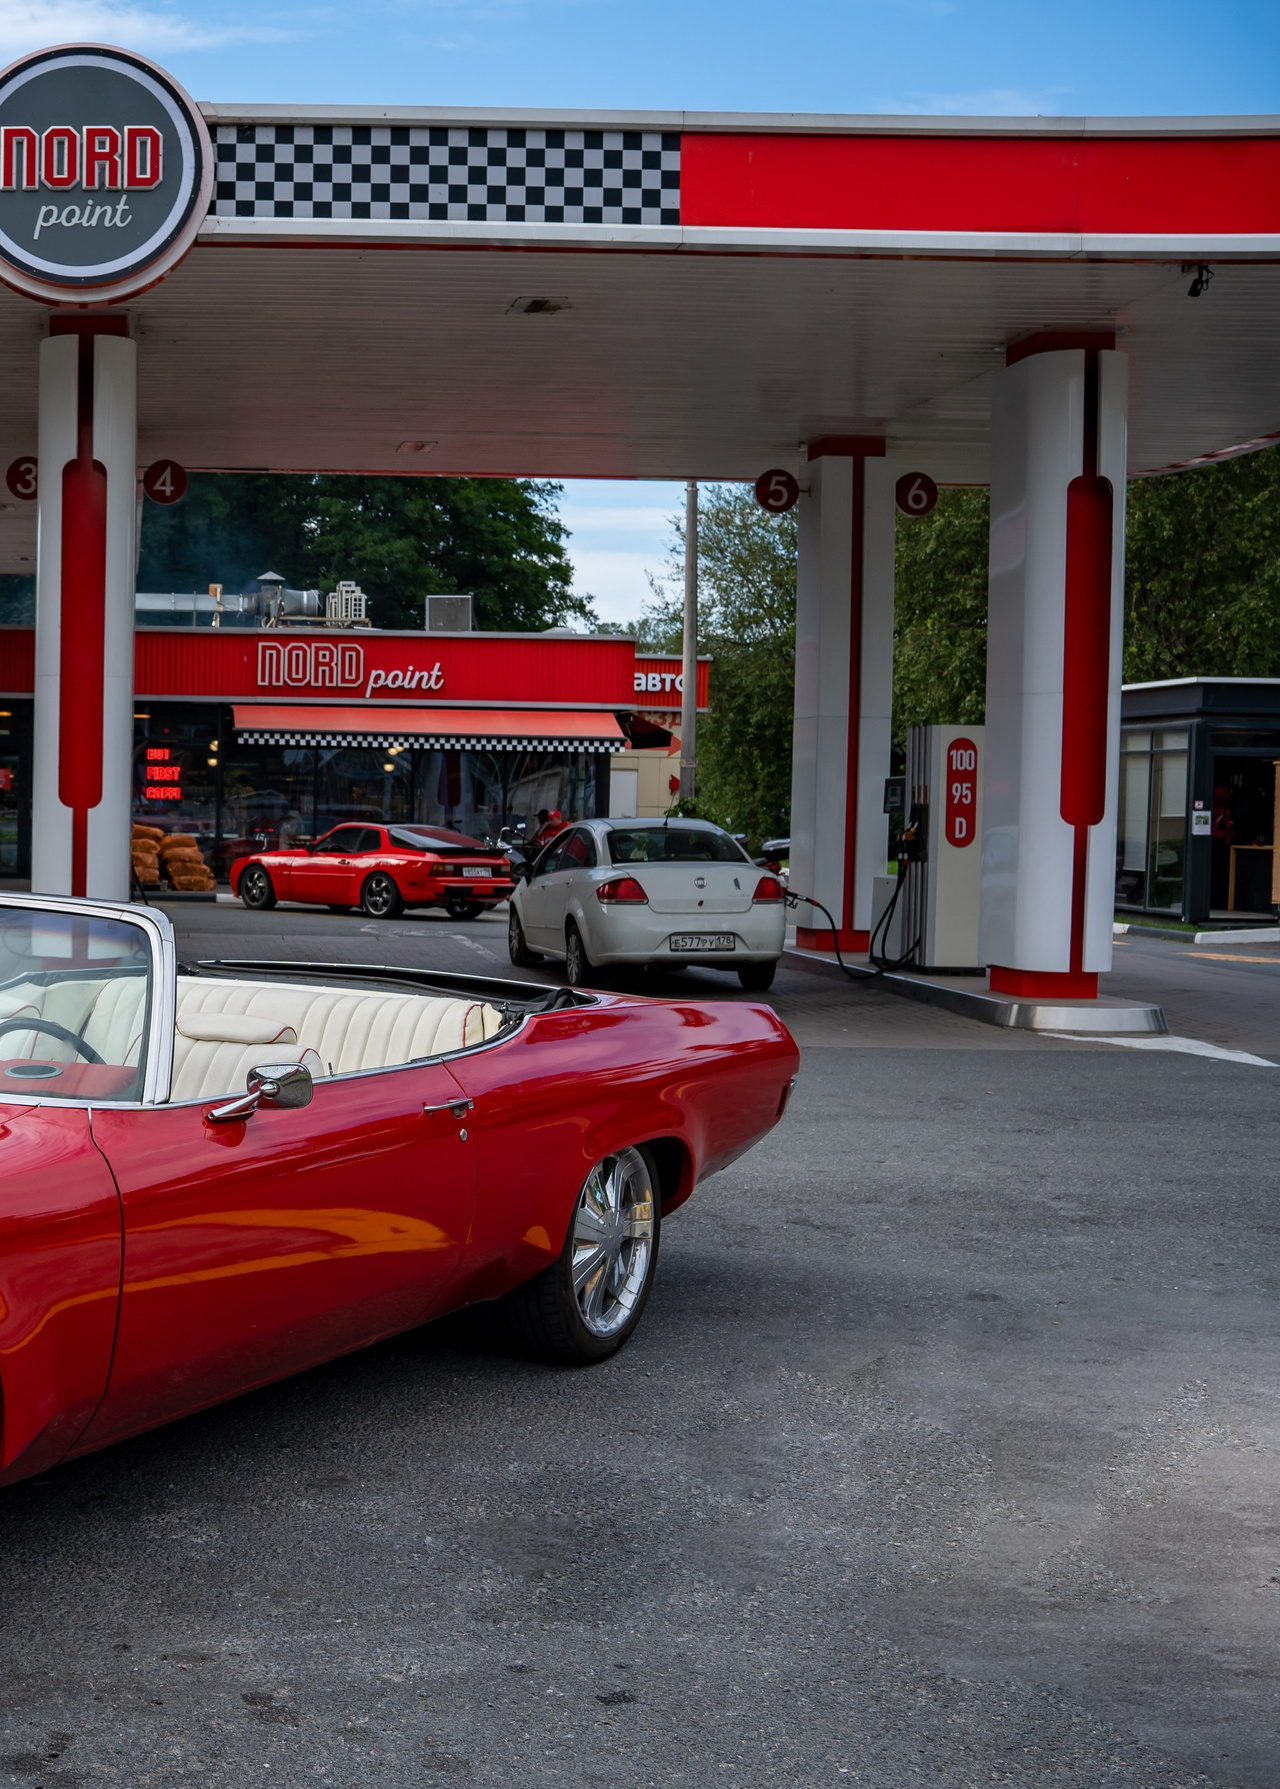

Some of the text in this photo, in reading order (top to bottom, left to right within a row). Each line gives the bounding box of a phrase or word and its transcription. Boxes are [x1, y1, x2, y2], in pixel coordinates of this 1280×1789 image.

[0, 125, 164, 191] NORD
[33, 194, 132, 240] point
[16, 463, 38, 494] 3
[152, 465, 175, 496] 4
[767, 476, 788, 506] 5
[907, 478, 928, 509] 6
[257, 642, 445, 698] NORD point
[146, 766, 181, 780] FIRST
[949, 749, 975, 771] 100
[951, 782, 972, 804] 95
[954, 817, 967, 838] D
